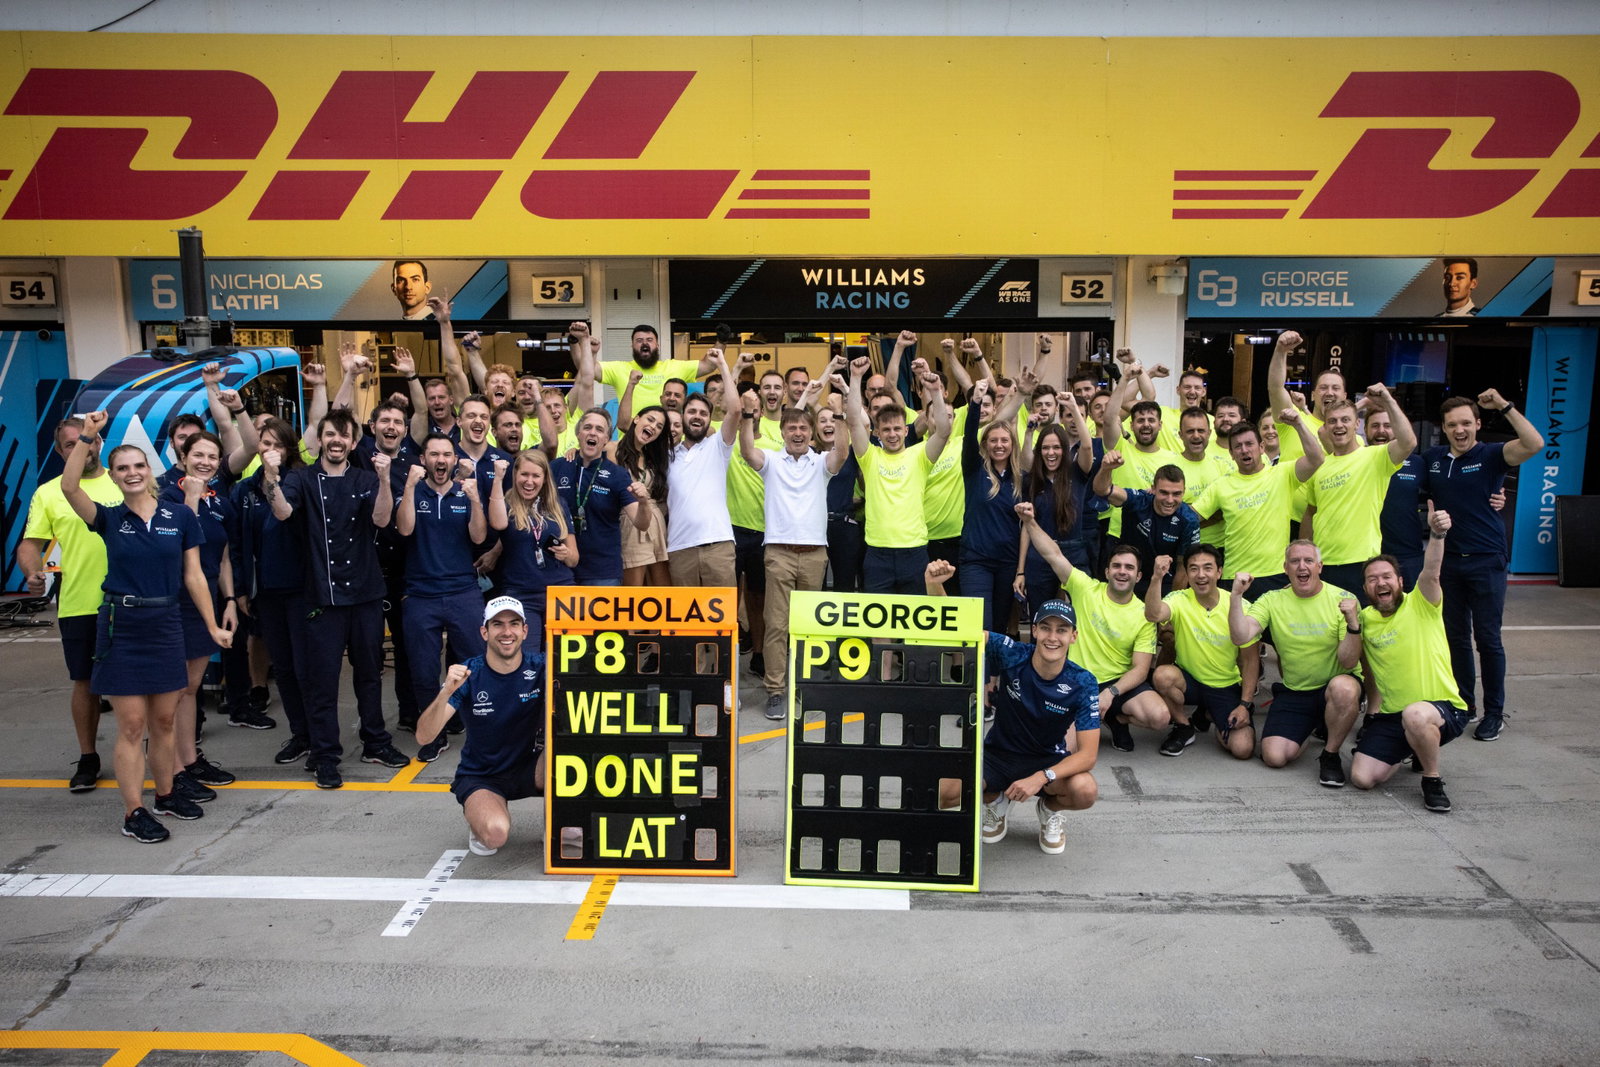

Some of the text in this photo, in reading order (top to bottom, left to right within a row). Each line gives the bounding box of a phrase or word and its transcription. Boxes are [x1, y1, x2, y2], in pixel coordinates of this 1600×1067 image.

[2, 68, 741, 220] DHL
[210, 273, 323, 290] NICHOLAS
[801, 267, 926, 286] WILLIAMS
[1261, 271, 1350, 287] GEORGE
[9, 280, 46, 300] 54
[151, 274, 177, 309] 6
[540, 280, 574, 301] 53
[1070, 279, 1104, 299] 52
[1198, 269, 1238, 307] 63
[1589, 278, 1600, 298] 5
[211, 294, 280, 310] LATIFI
[816, 291, 910, 309] RACING
[1260, 291, 1354, 307] RUSSELL
[1537, 356, 1570, 545] WILLIAMS RACING
[1319, 472, 1351, 484] WILLIAMS
[1321, 480, 1346, 491] RACING
[555, 596, 725, 623] NICHOLAS
[814, 601, 959, 632] GEORGE
[1043, 602, 1072, 612] WILLIAMS
[560, 631, 626, 674] P8
[802, 638, 871, 680] P9
[566, 691, 684, 735] WELL
[1044, 700, 1070, 712] WILLIAMS
[1046, 706, 1065, 715] RACING
[555, 753, 698, 798] DONE
[599, 817, 676, 858] LAT
